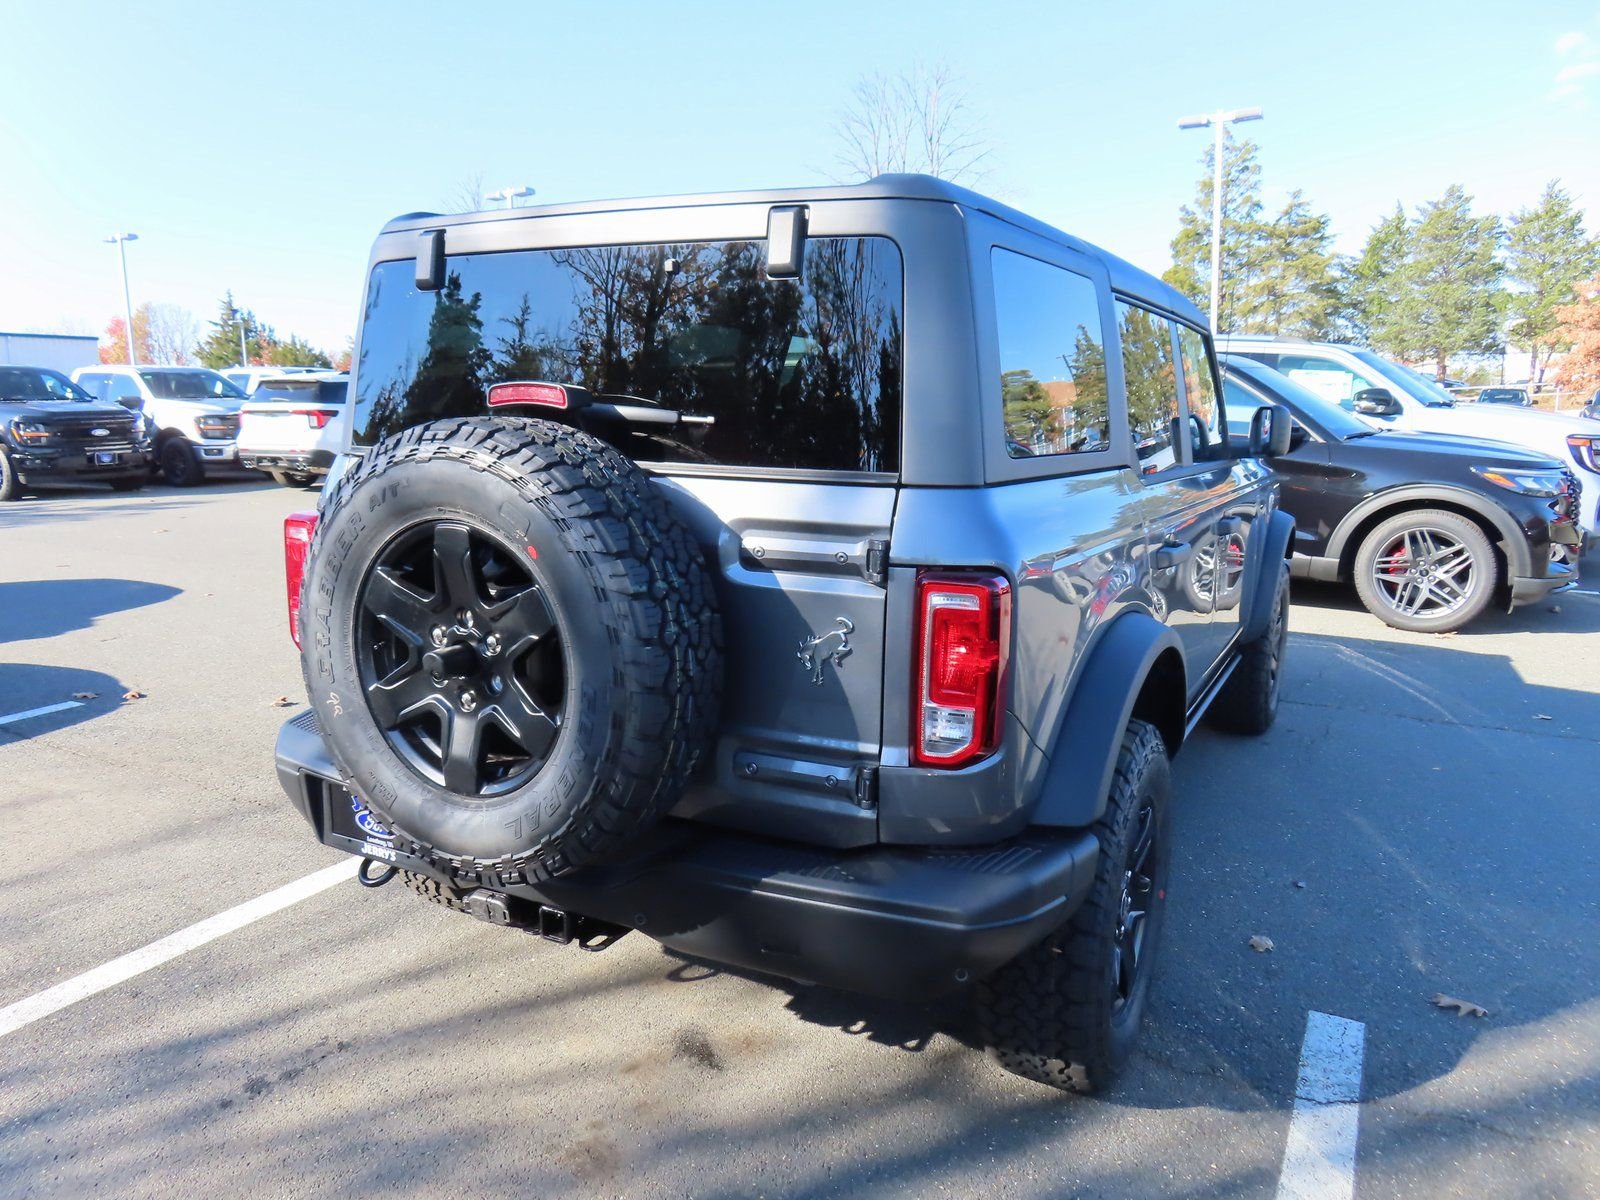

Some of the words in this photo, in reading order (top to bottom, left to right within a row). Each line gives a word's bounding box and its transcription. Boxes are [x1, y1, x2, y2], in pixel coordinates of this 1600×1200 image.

[315, 511, 367, 685] GRABBER
[504, 682, 597, 840] GENERAL
[361, 842, 396, 862] JERRY'S
